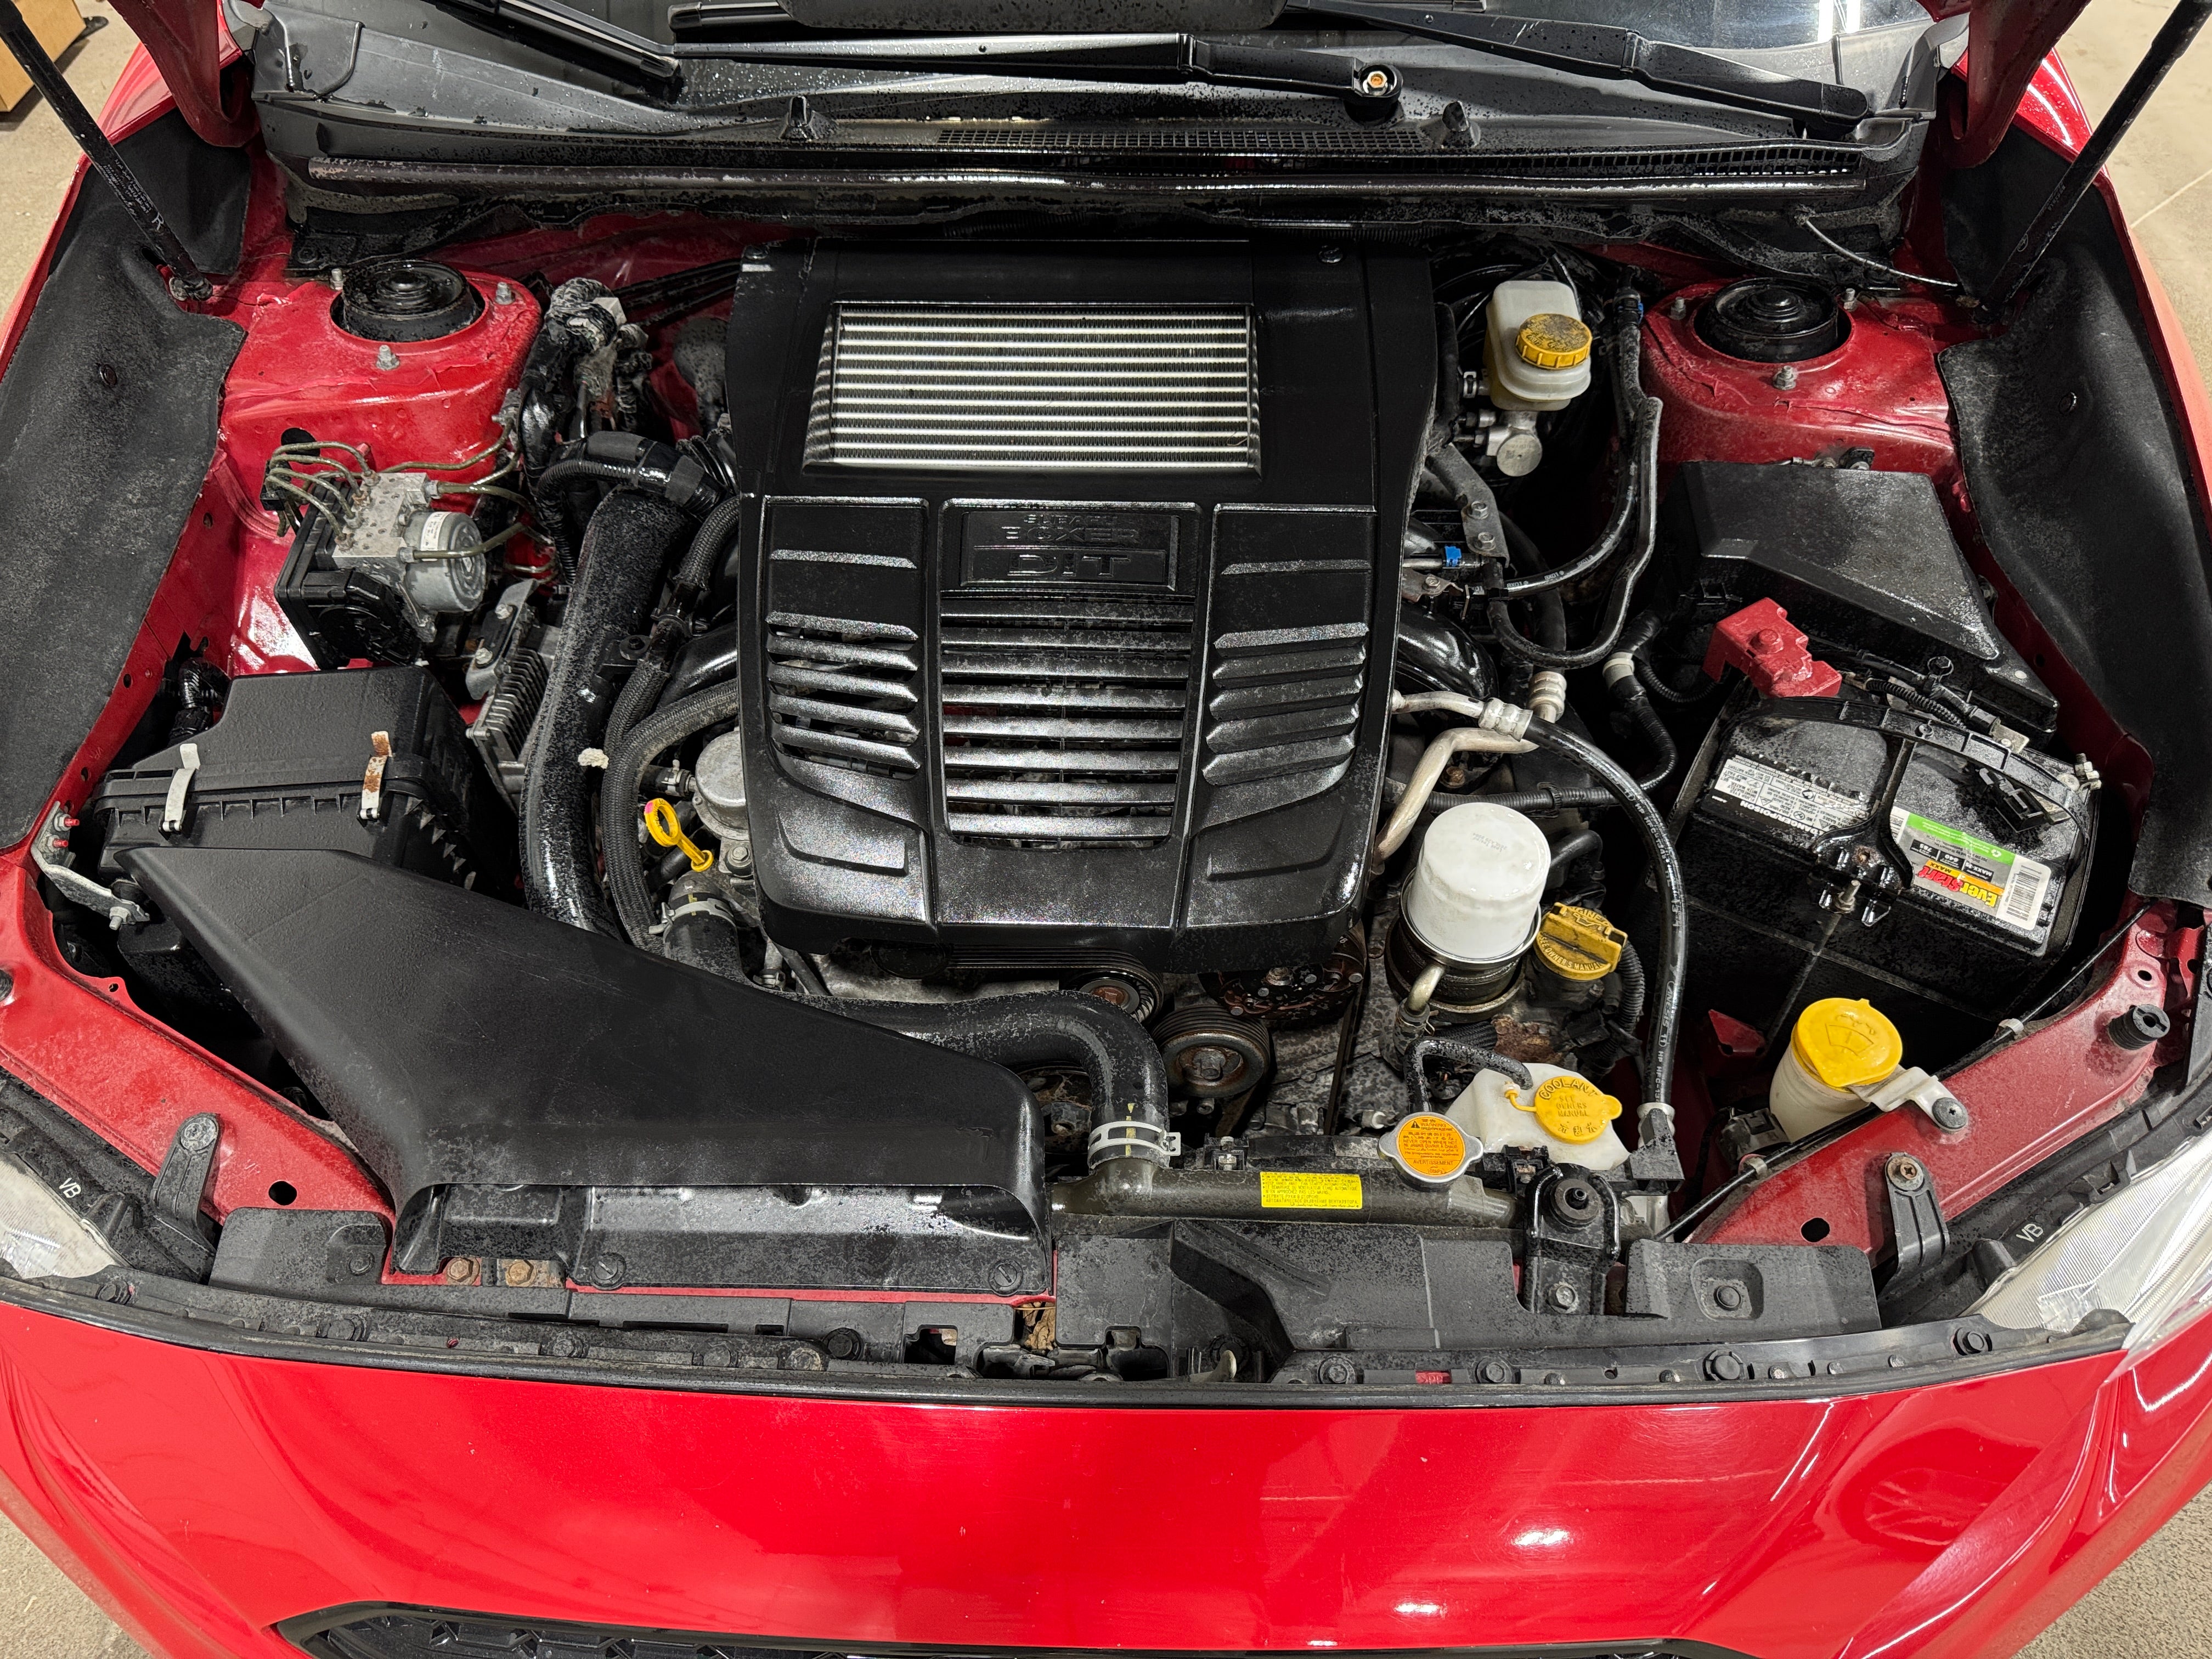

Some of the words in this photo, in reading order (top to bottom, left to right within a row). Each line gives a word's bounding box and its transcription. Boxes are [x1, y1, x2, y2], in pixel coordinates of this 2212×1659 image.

[151, 212, 164, 230] R
[1002, 525, 1139, 543] BOXER
[1007, 552, 1132, 578] DIT
[1635, 803, 1645, 814] HP
[1928, 861, 1952, 874] MAXX
[1916, 864, 1999, 908] EverStart
[1539, 935, 1547, 947] SEE
[1545, 947, 1572, 968] OWNER'S
[1574, 962, 1604, 971] MANUAL
[1657, 1051, 1664, 1063] HP
[1539, 1078, 1598, 1101] COOLANT
[1559, 1094, 1575, 1102] SEE
[59, 1177, 82, 1198] VB
[2016, 1223, 2044, 1243] VB
